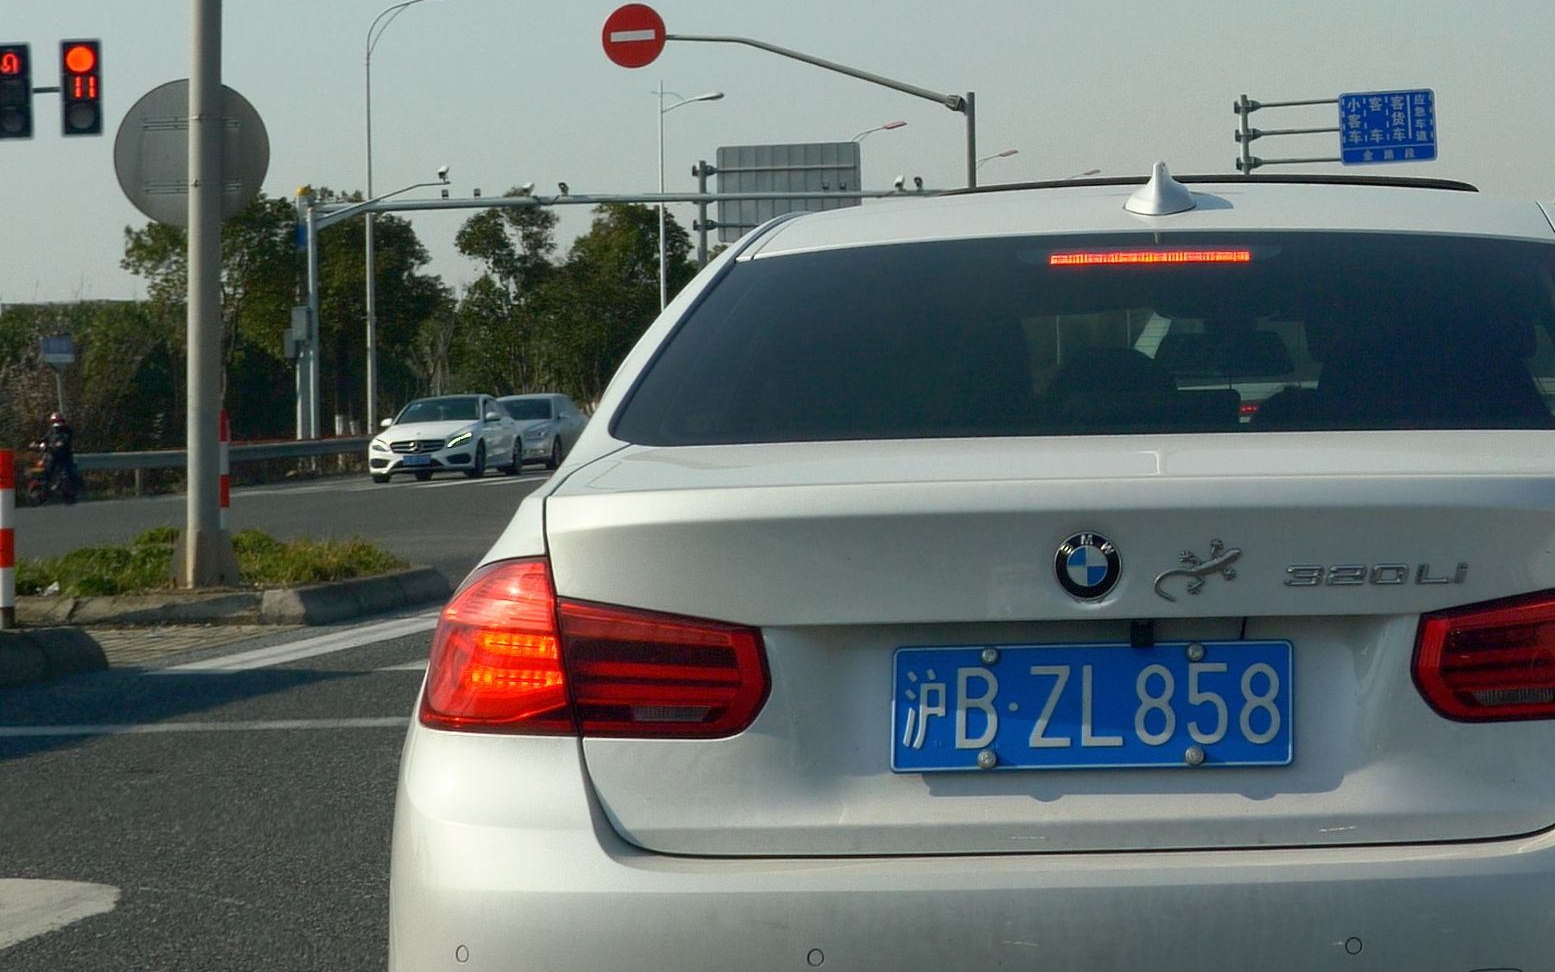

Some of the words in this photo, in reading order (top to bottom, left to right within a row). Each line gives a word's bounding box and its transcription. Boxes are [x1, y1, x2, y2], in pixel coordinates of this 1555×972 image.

[75, 76, 96, 98] 11
[1348, 99, 1363, 143] 小客车
[1391, 96, 1406, 141] 客货车
[1059, 534, 1115, 555] BMW
[1283, 561, 1469, 586] 320Li
